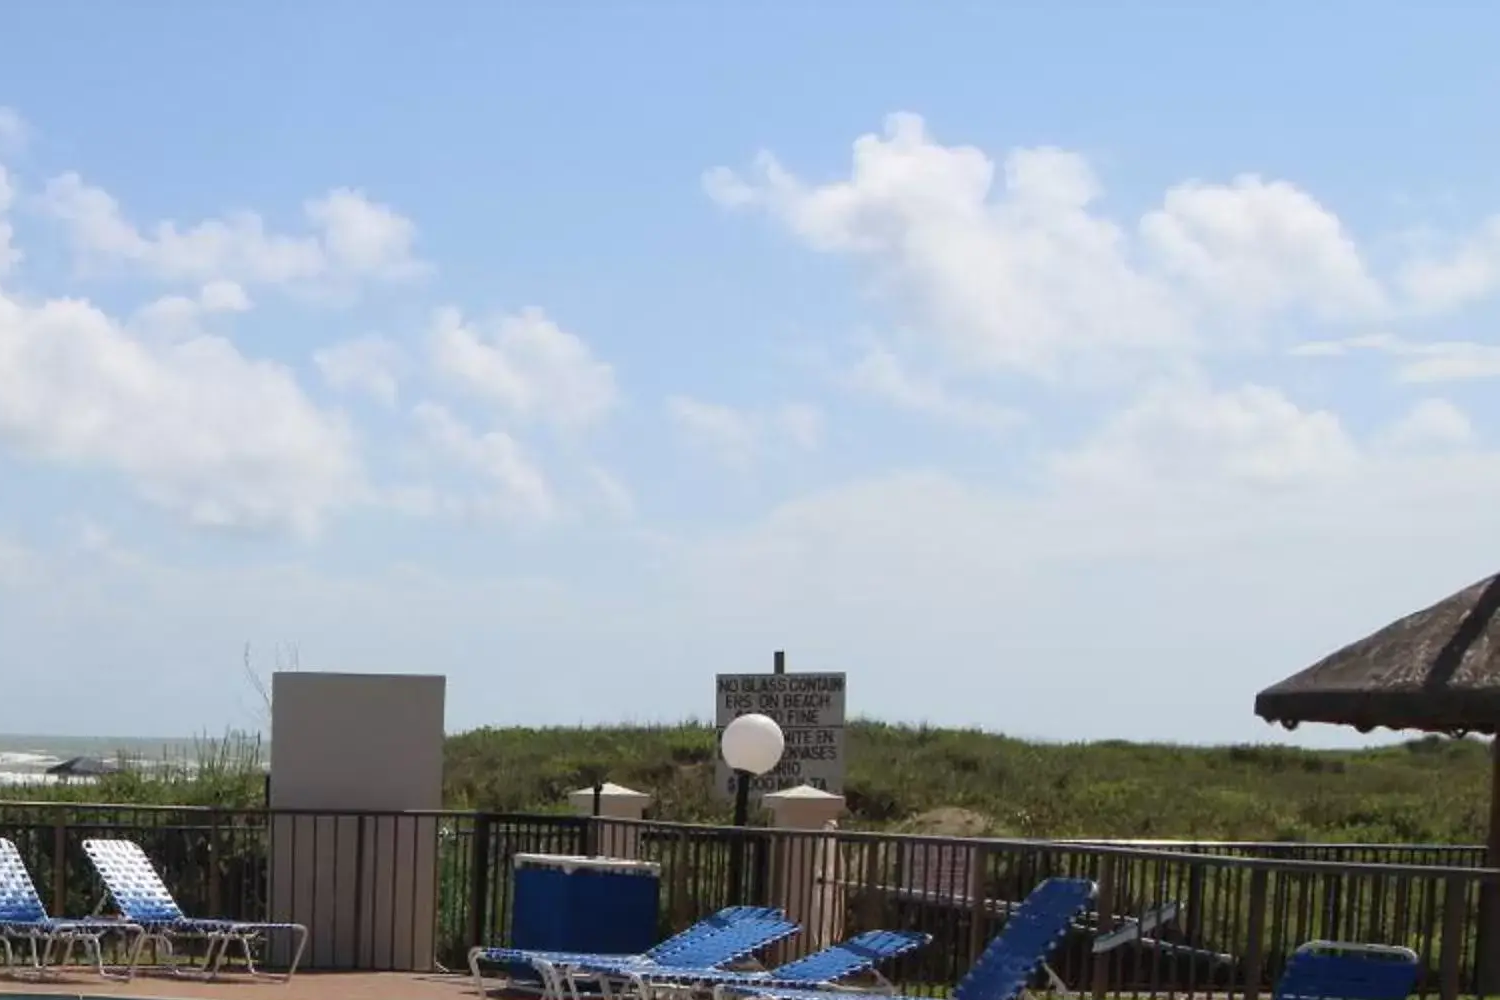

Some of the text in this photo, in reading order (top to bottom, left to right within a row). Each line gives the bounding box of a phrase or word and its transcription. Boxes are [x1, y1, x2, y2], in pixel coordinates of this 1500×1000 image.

[719, 678, 739, 692] NO
[741, 677, 788, 692] GLASS
[725, 693, 831, 709] ERS ON BEACH
[787, 709, 820, 723] FINE
